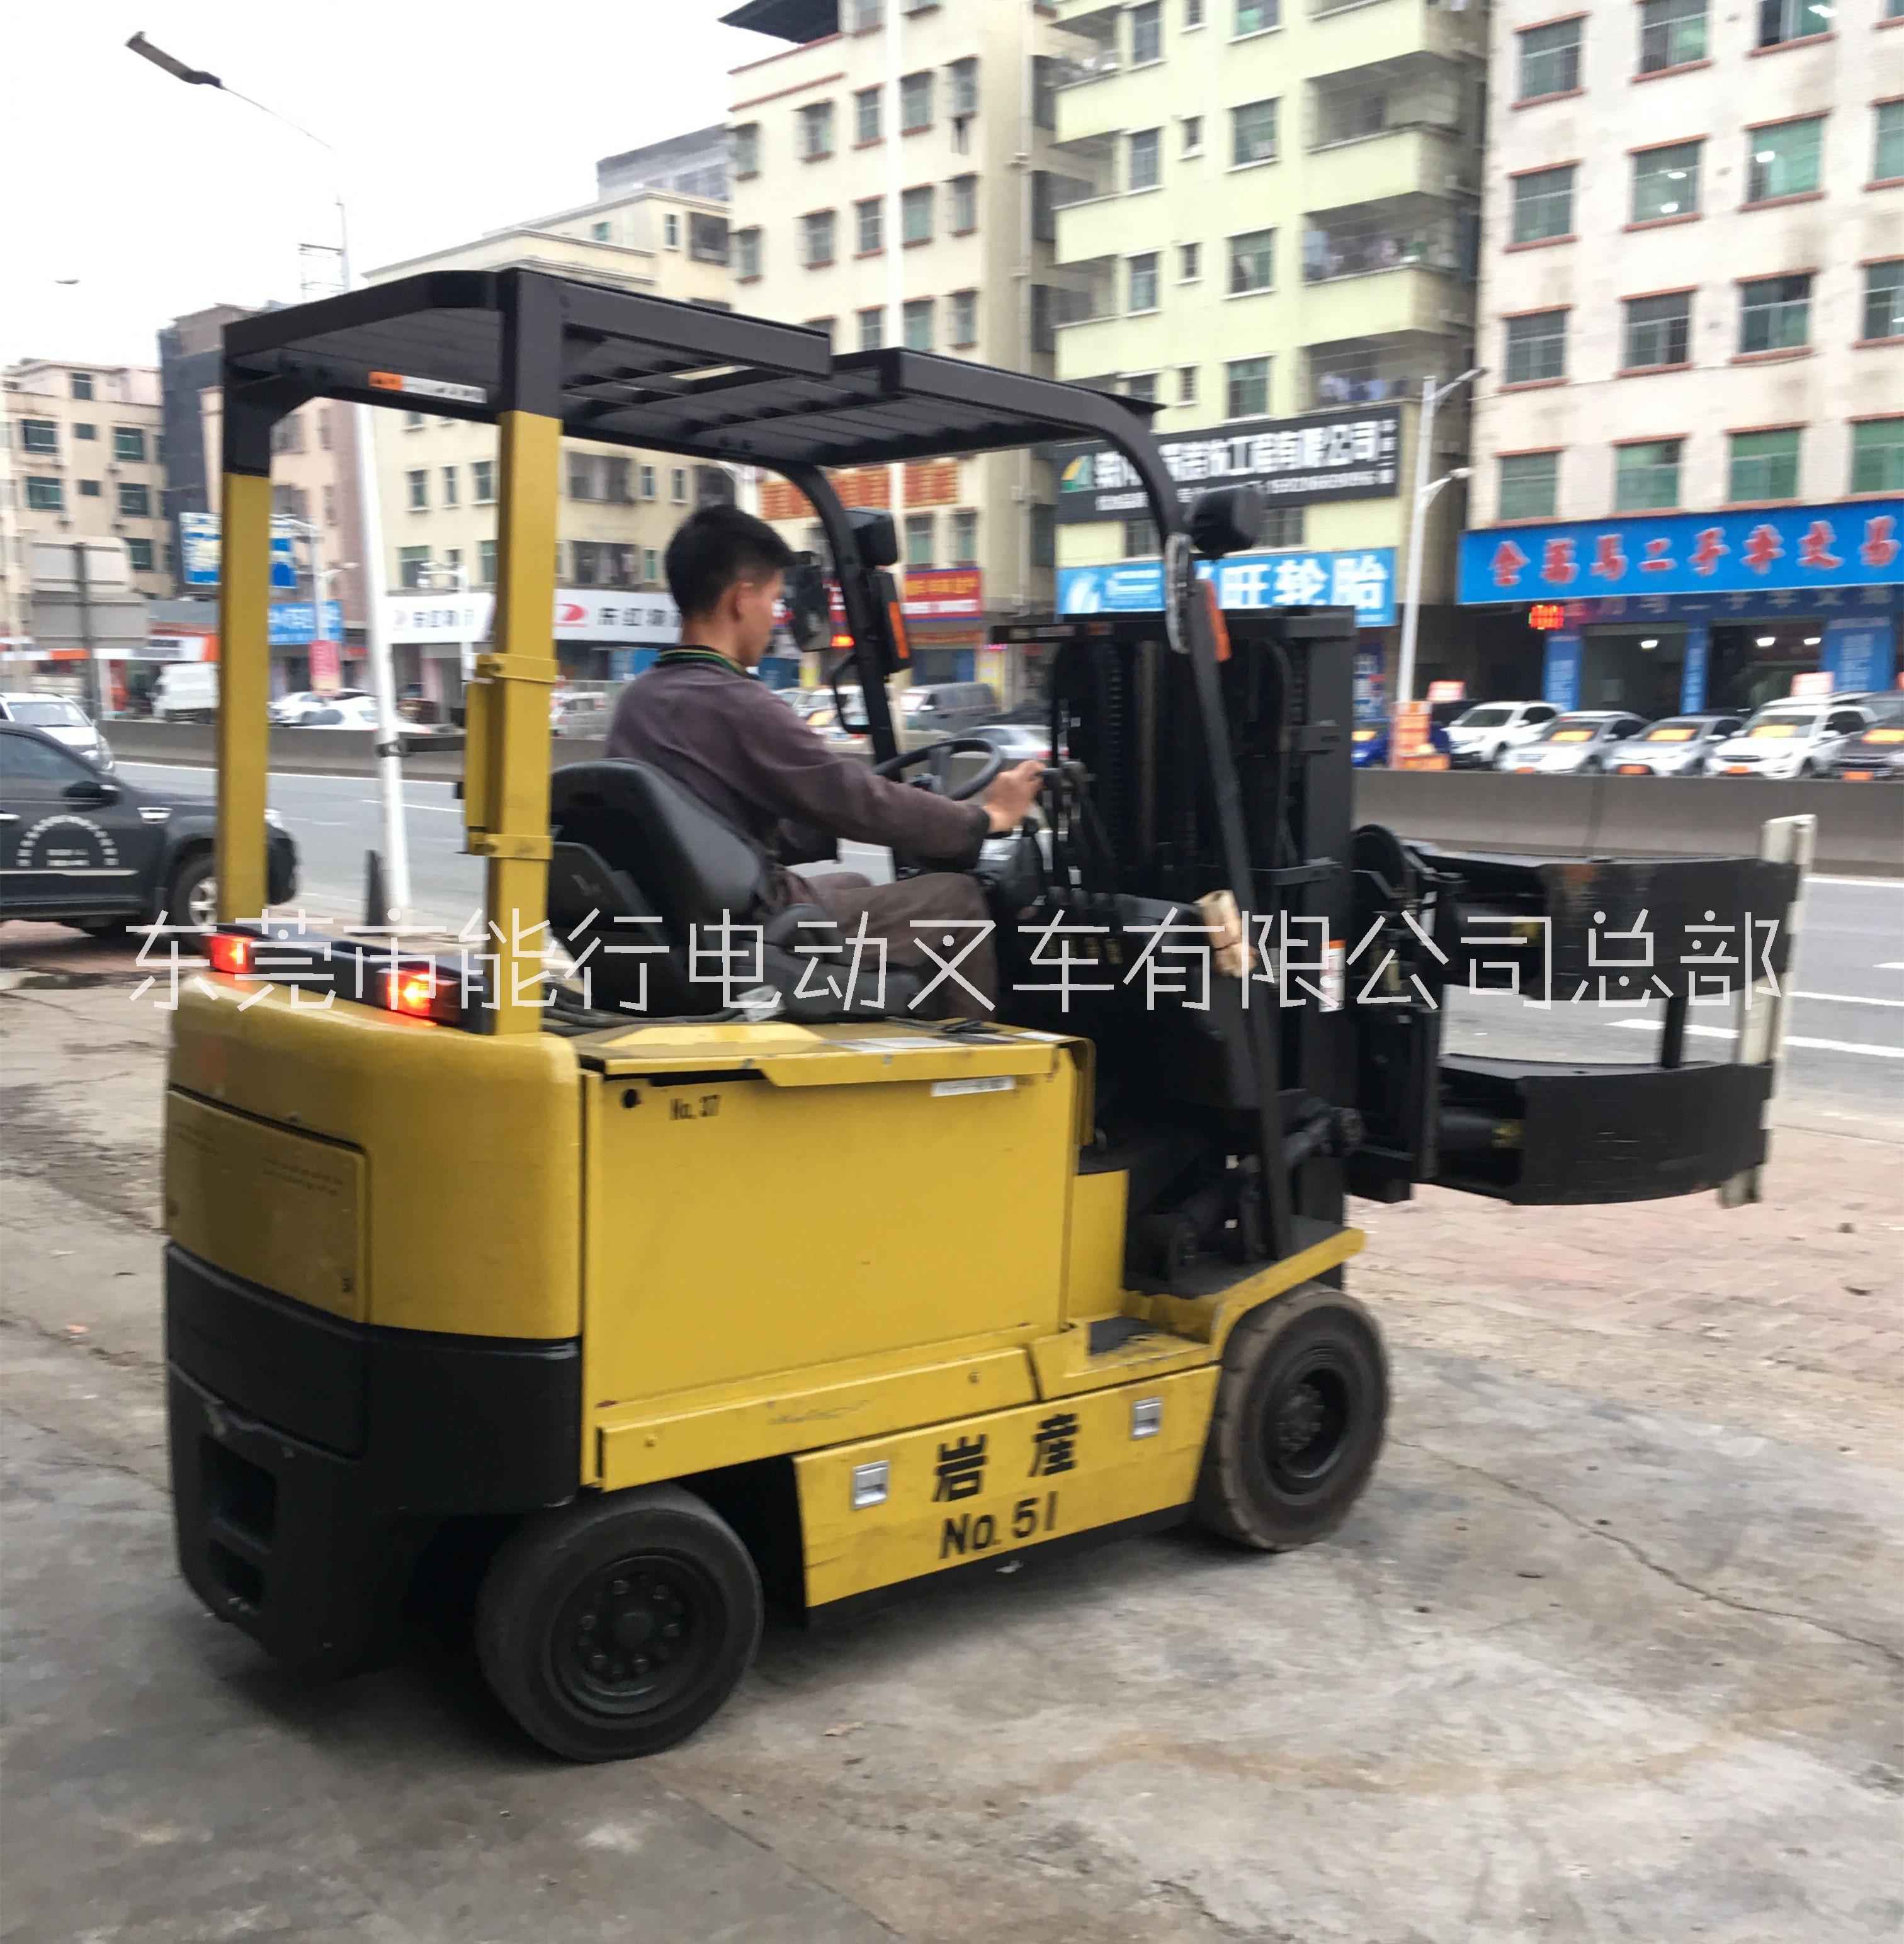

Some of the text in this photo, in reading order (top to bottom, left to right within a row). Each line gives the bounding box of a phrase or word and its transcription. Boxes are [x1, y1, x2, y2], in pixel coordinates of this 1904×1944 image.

[1194, 554, 1388, 610] 旺轮胎
[1012, 1490, 1058, 1539] 51
